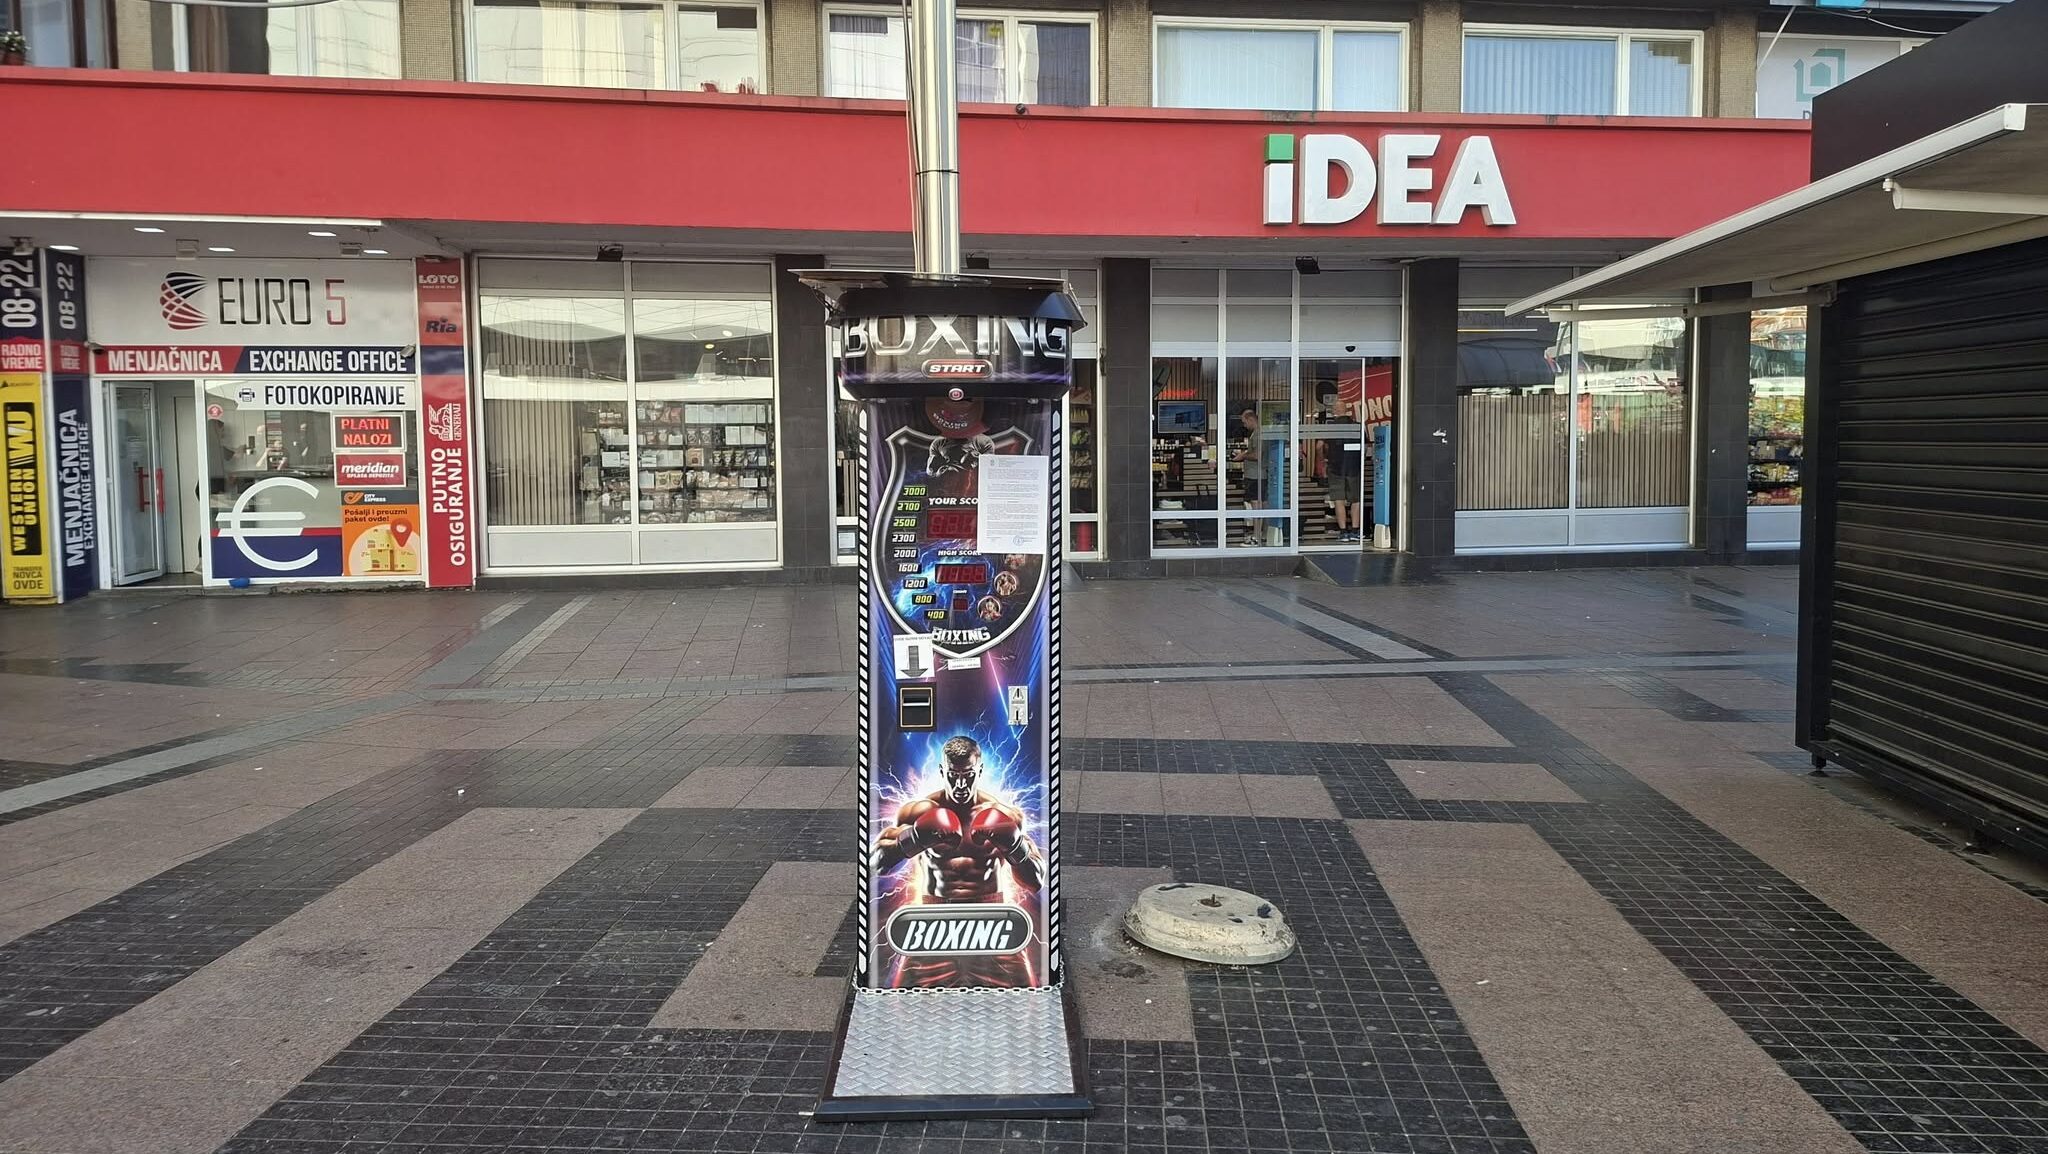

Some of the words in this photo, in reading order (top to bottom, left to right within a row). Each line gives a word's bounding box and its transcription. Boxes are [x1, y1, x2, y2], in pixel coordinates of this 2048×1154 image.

[418, 274, 459, 284] LOTO
[0, 259, 37, 327] 08-22
[56, 262, 76, 330] 08-22
[217, 277, 312, 325] EURO
[325, 279, 346, 326] 5
[425, 317, 457, 333] Ria
[841, 315, 1067, 358] BOXING
[1, 344, 41, 356] RADNO
[1, 357, 43, 369] VREME
[108, 347, 223, 372] MENJAČNICA
[249, 350, 343, 372] EXCHANGE
[347, 349, 407, 372] OFFICE
[929, 364, 986, 373] START
[265, 386, 406, 406] FOTOKOPIRANJE
[341, 418, 389, 430] PLATNI
[452, 403, 462, 441] GENERALI
[343, 434, 392, 445] NALOZI
[78, 422, 91, 471] OFFICE
[341, 462, 399, 473] meridian
[431, 447, 448, 513] PUTNO
[59, 409, 85, 567] MENJAČNICA
[903, 487, 926, 496] 3000
[22, 468, 37, 526] UNION
[10, 468, 26, 552] WESTERN
[81, 474, 95, 550] EXCHANGE
[447, 448, 466, 566] OSIGURANJE
[897, 502, 920, 511] 2700
[344, 516, 366, 524] paket
[893, 518, 916, 527] 2500
[892, 534, 915, 542] 2300
[893, 549, 917, 558] 2000
[898, 563, 919, 572] 1600
[13, 571, 43, 579] NOVCA
[14, 580, 45, 590] OVDE
[905, 579, 925, 588] 1200
[915, 595, 932, 604] 800
[927, 611, 944, 619] 400
[933, 626, 991, 645] BOXING
[902, 919, 1014, 950] BOXING
